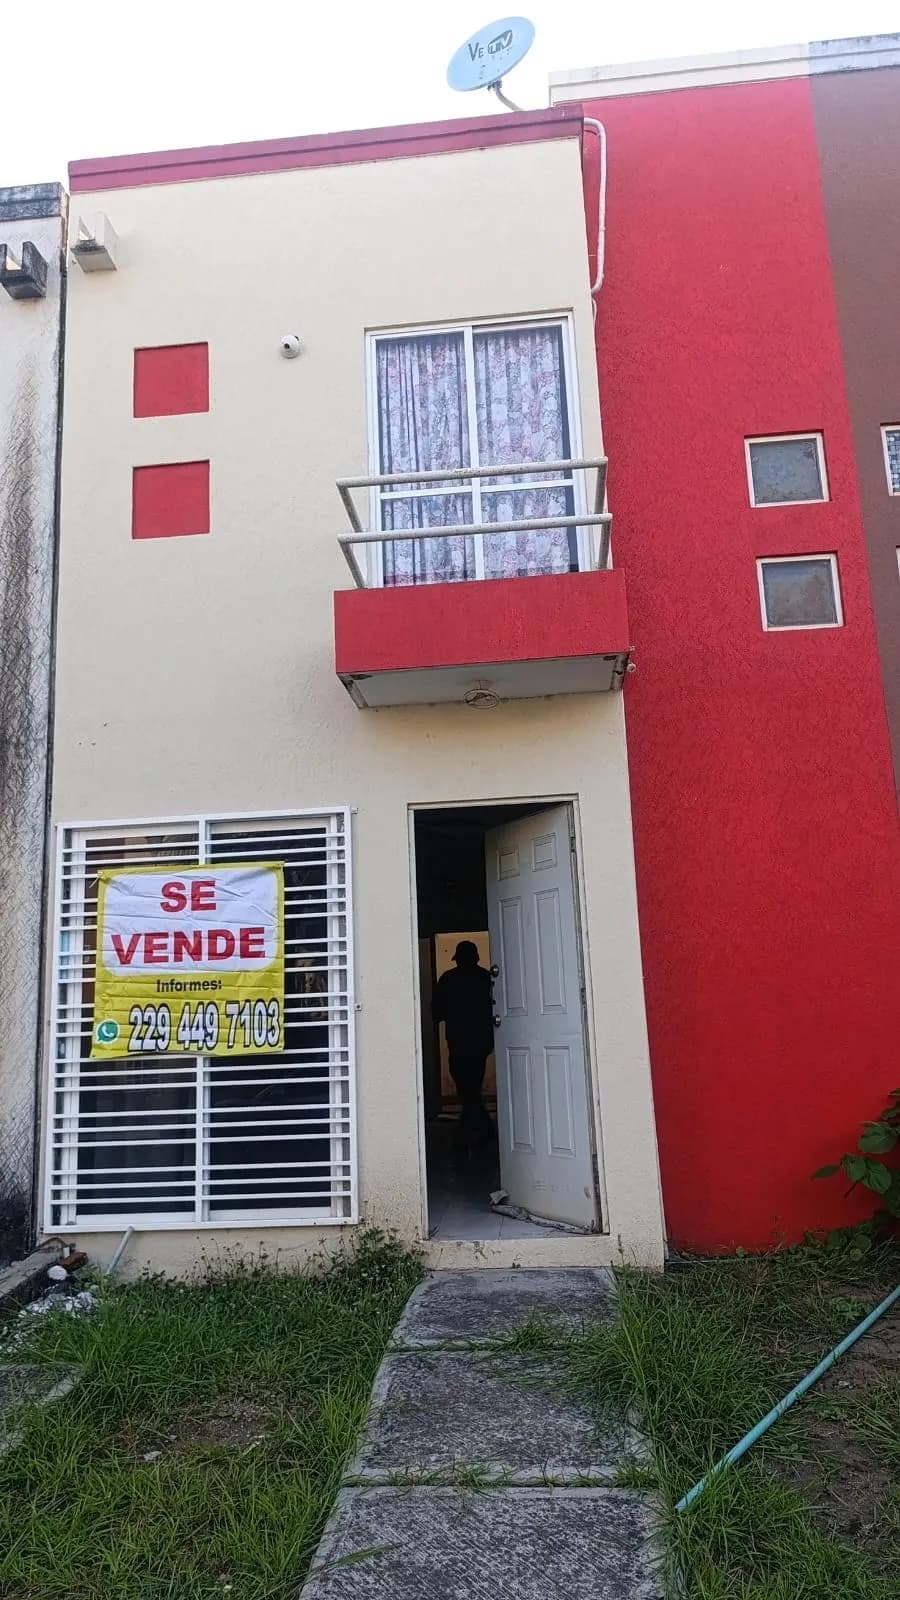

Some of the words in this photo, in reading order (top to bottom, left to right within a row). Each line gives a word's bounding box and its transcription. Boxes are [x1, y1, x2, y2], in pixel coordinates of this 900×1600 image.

[160, 880, 216, 912] SE
[111, 927, 266, 965] VENDE
[156, 979, 222, 993] Informes:
[127, 1003, 171, 1052] 229
[177, 1000, 219, 1050] 449
[225, 998, 280, 1049] 7103
